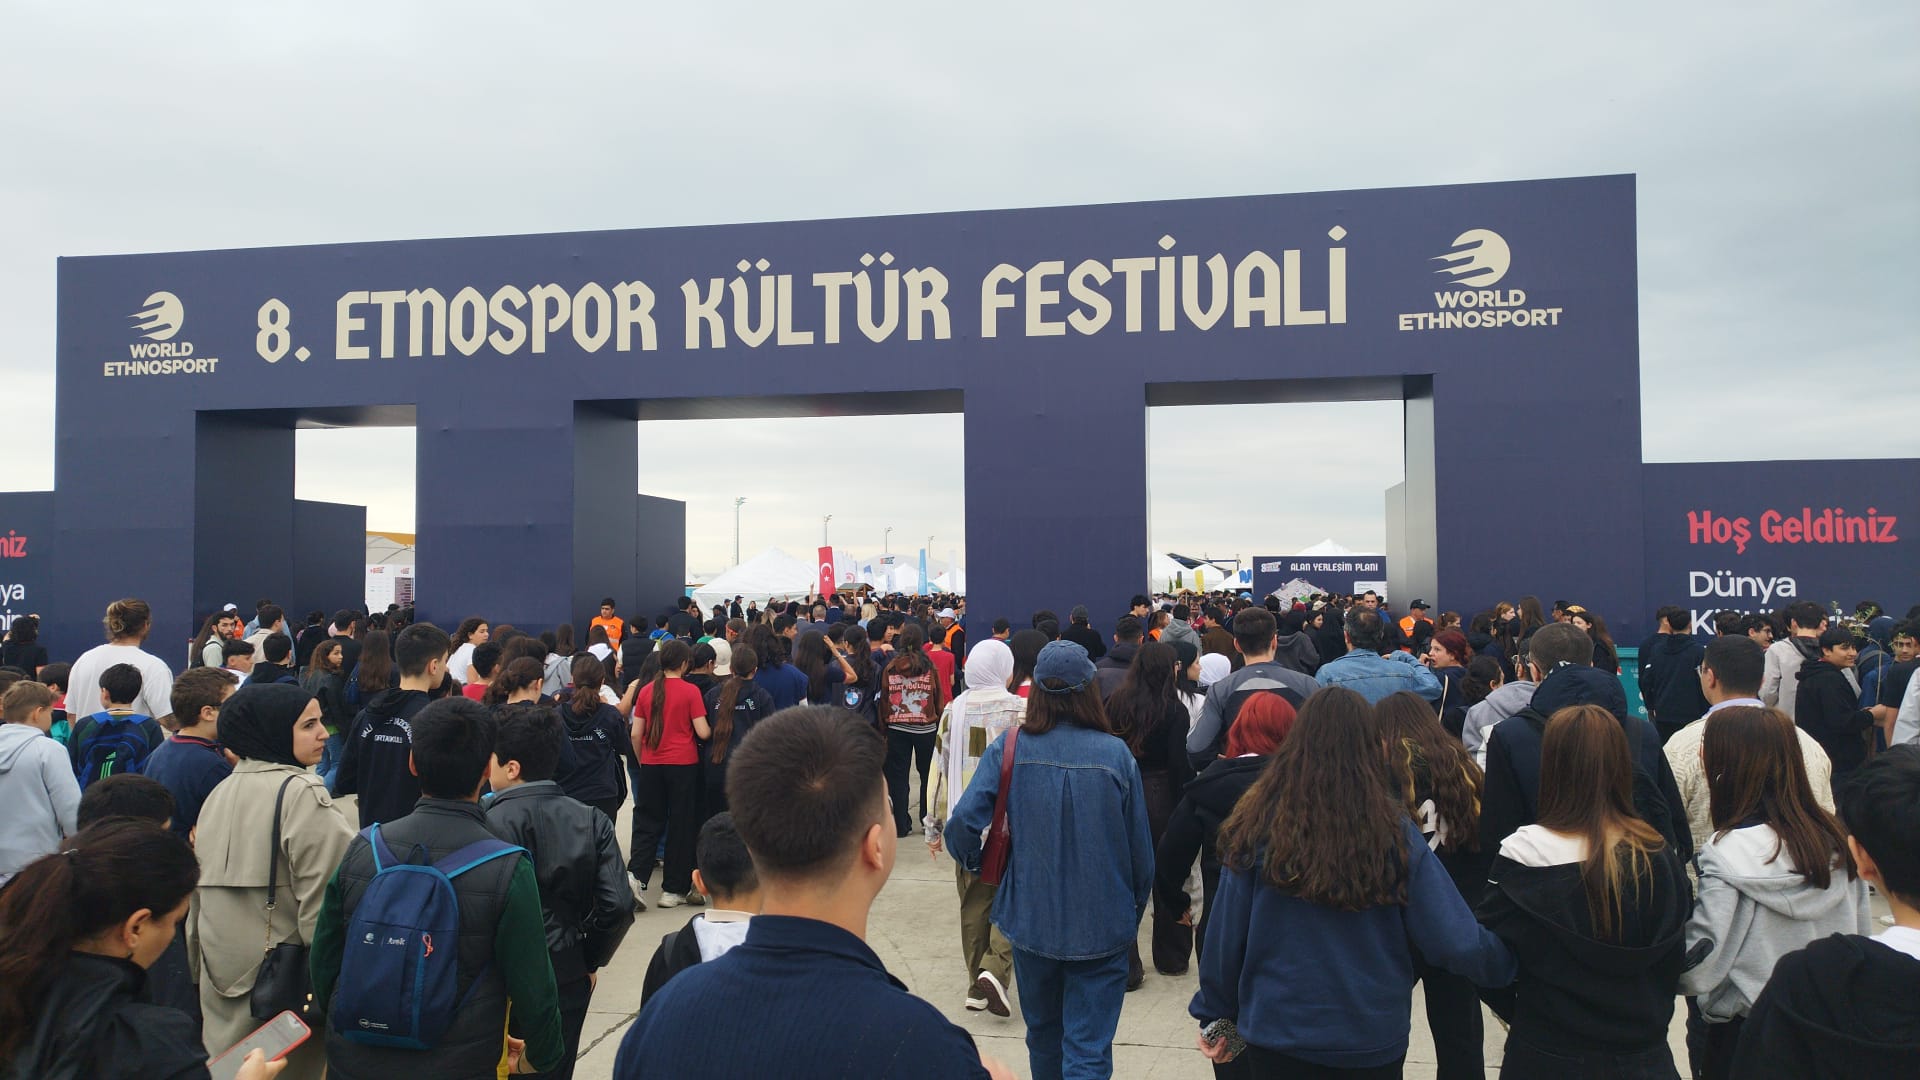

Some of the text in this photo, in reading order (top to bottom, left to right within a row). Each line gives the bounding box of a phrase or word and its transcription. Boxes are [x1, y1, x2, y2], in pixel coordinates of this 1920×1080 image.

[256, 225, 1347, 363] 8. ETNOSPOR KÜLTÜR FESTİVALİ
[1434, 289, 1526, 308] WORLD
[1399, 308, 1563, 331] ETHNOSPORT
[129, 342, 194, 358] WORLD
[103, 358, 219, 377] ETHNOSPORT
[1687, 507, 1899, 555] Hoş Geldiniz
[1290, 563, 1311, 572] ALAN
[1313, 561, 1352, 573] YERLEŞİM
[1355, 562, 1379, 572] PLANI
[1689, 570, 1797, 605] Dünya
